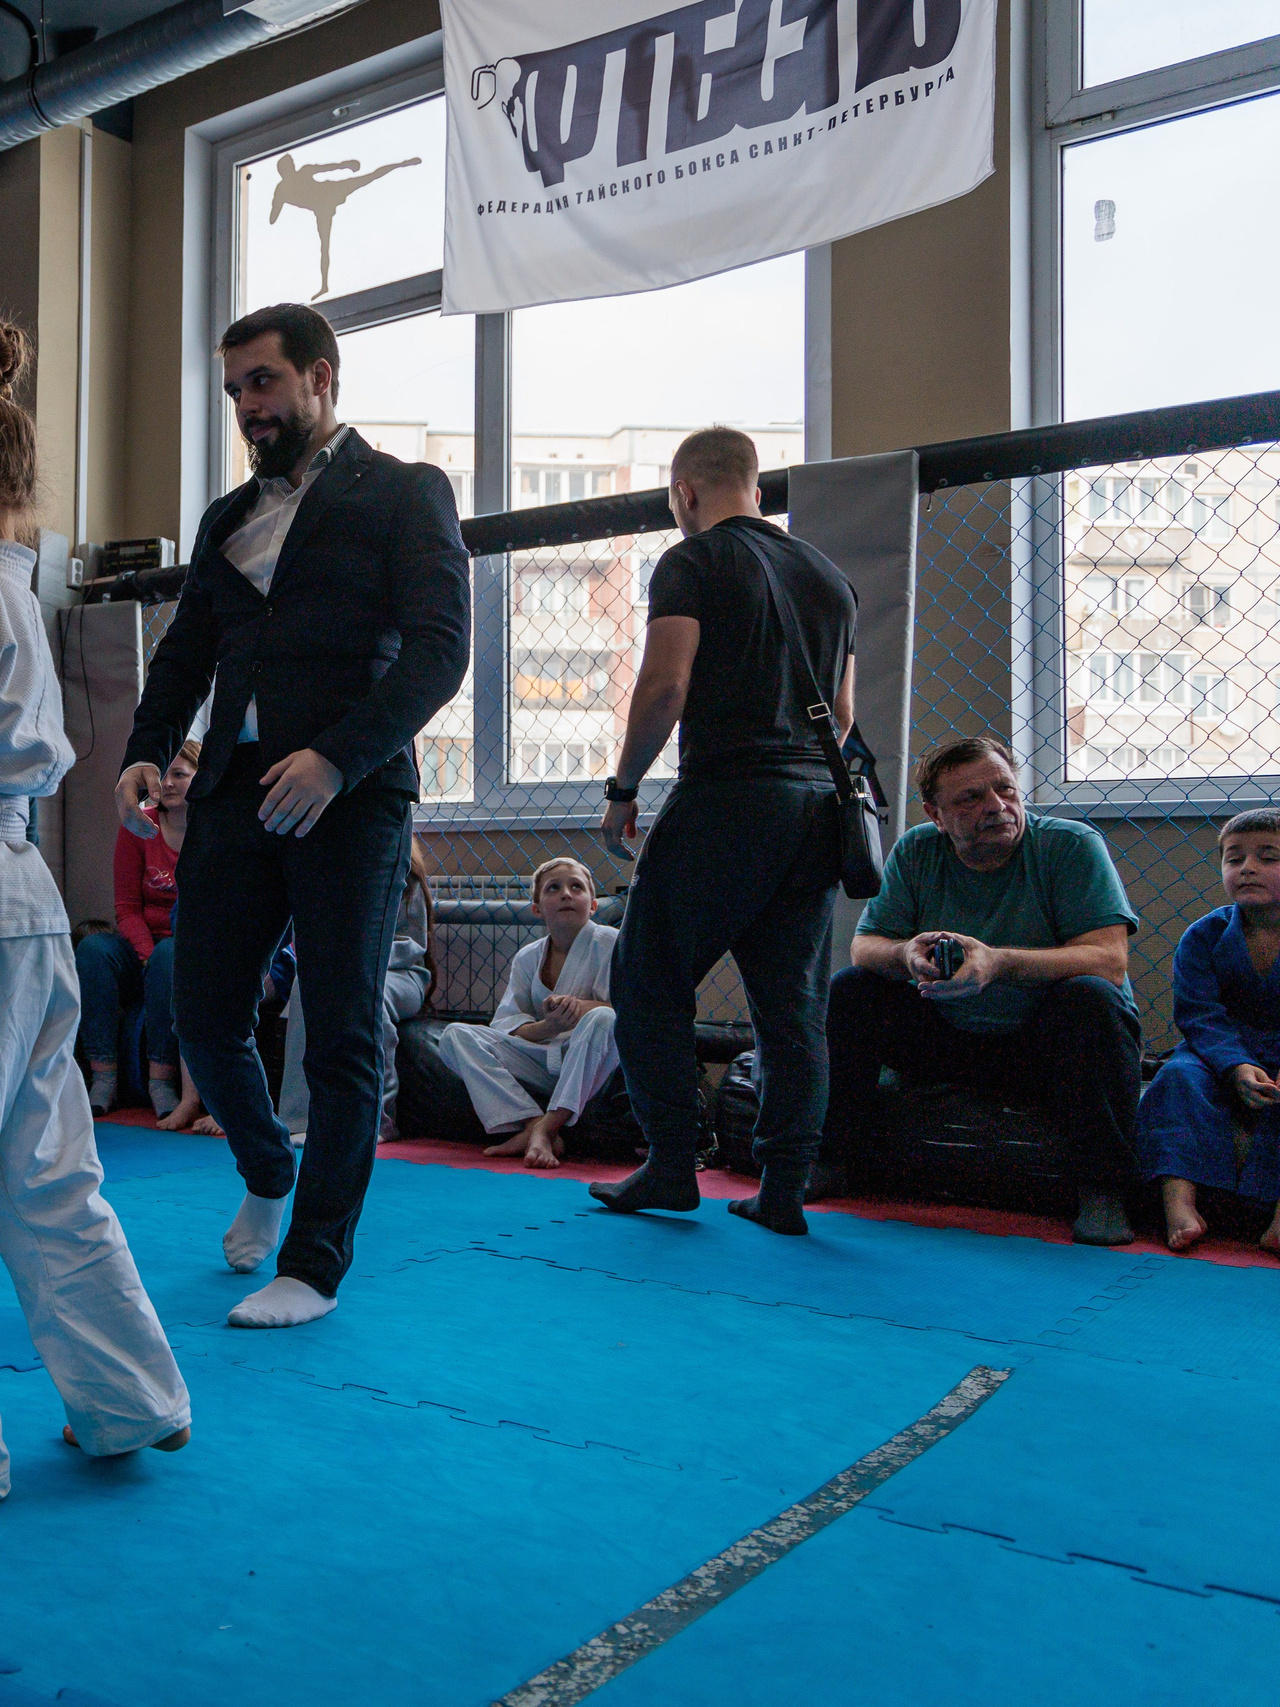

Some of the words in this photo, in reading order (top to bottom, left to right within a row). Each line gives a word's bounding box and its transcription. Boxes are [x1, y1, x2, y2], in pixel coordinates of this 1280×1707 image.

[477, 195, 570, 217] ФЕДЕРАЦИЯ
[576, 169, 667, 205] ТАЙСКОГО
[675, 150, 740, 180] БОКСА
[749, 66, 956, 159] САНКТ-ПЕТЕРБУРГА
